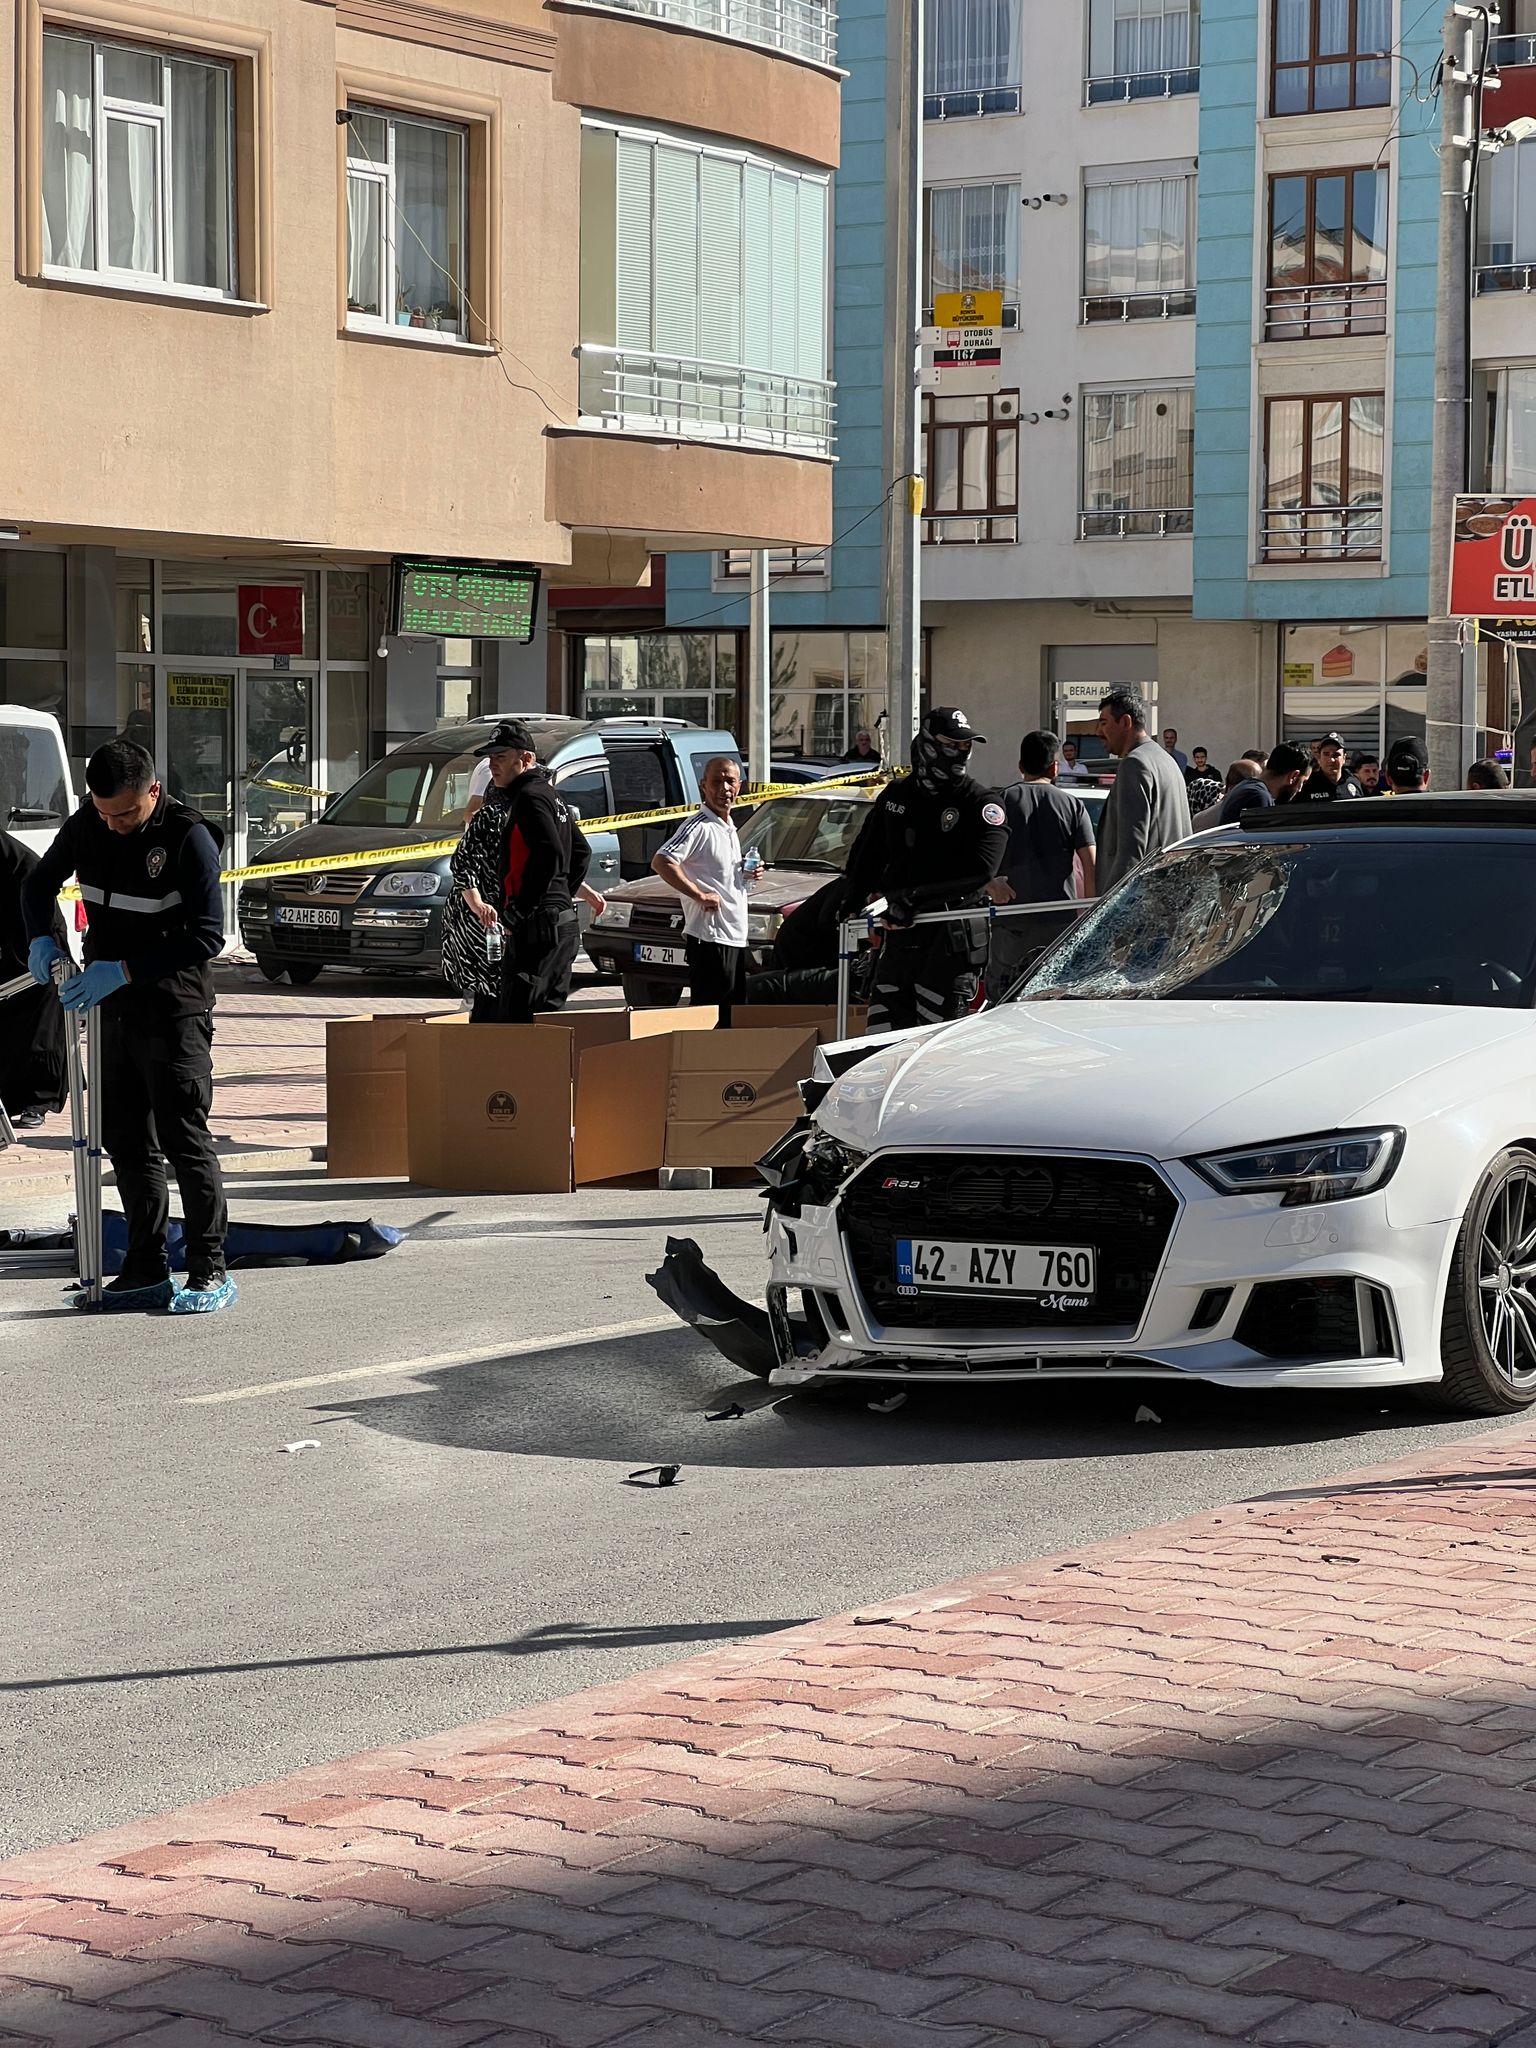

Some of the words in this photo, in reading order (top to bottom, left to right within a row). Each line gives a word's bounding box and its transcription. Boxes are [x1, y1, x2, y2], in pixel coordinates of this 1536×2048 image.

[964, 328, 993, 337] OTOBÜS
[964, 337, 993, 347] DURAĞI
[1069, 686, 1098, 696] BERAH
[281, 908, 294, 921] 42
[296, 909, 316, 923] AHE
[318, 911, 338, 924] 860
[641, 946, 653, 961] 42
[662, 948, 674, 963] ZH
[882, 1177, 921, 1189] RS3
[899, 1264, 912, 1275] TR
[914, 1245, 946, 1282] 42
[969, 1247, 1017, 1285] AZY
[1038, 1250, 1091, 1288] 760
[1039, 1293, 1090, 1312] Mami
